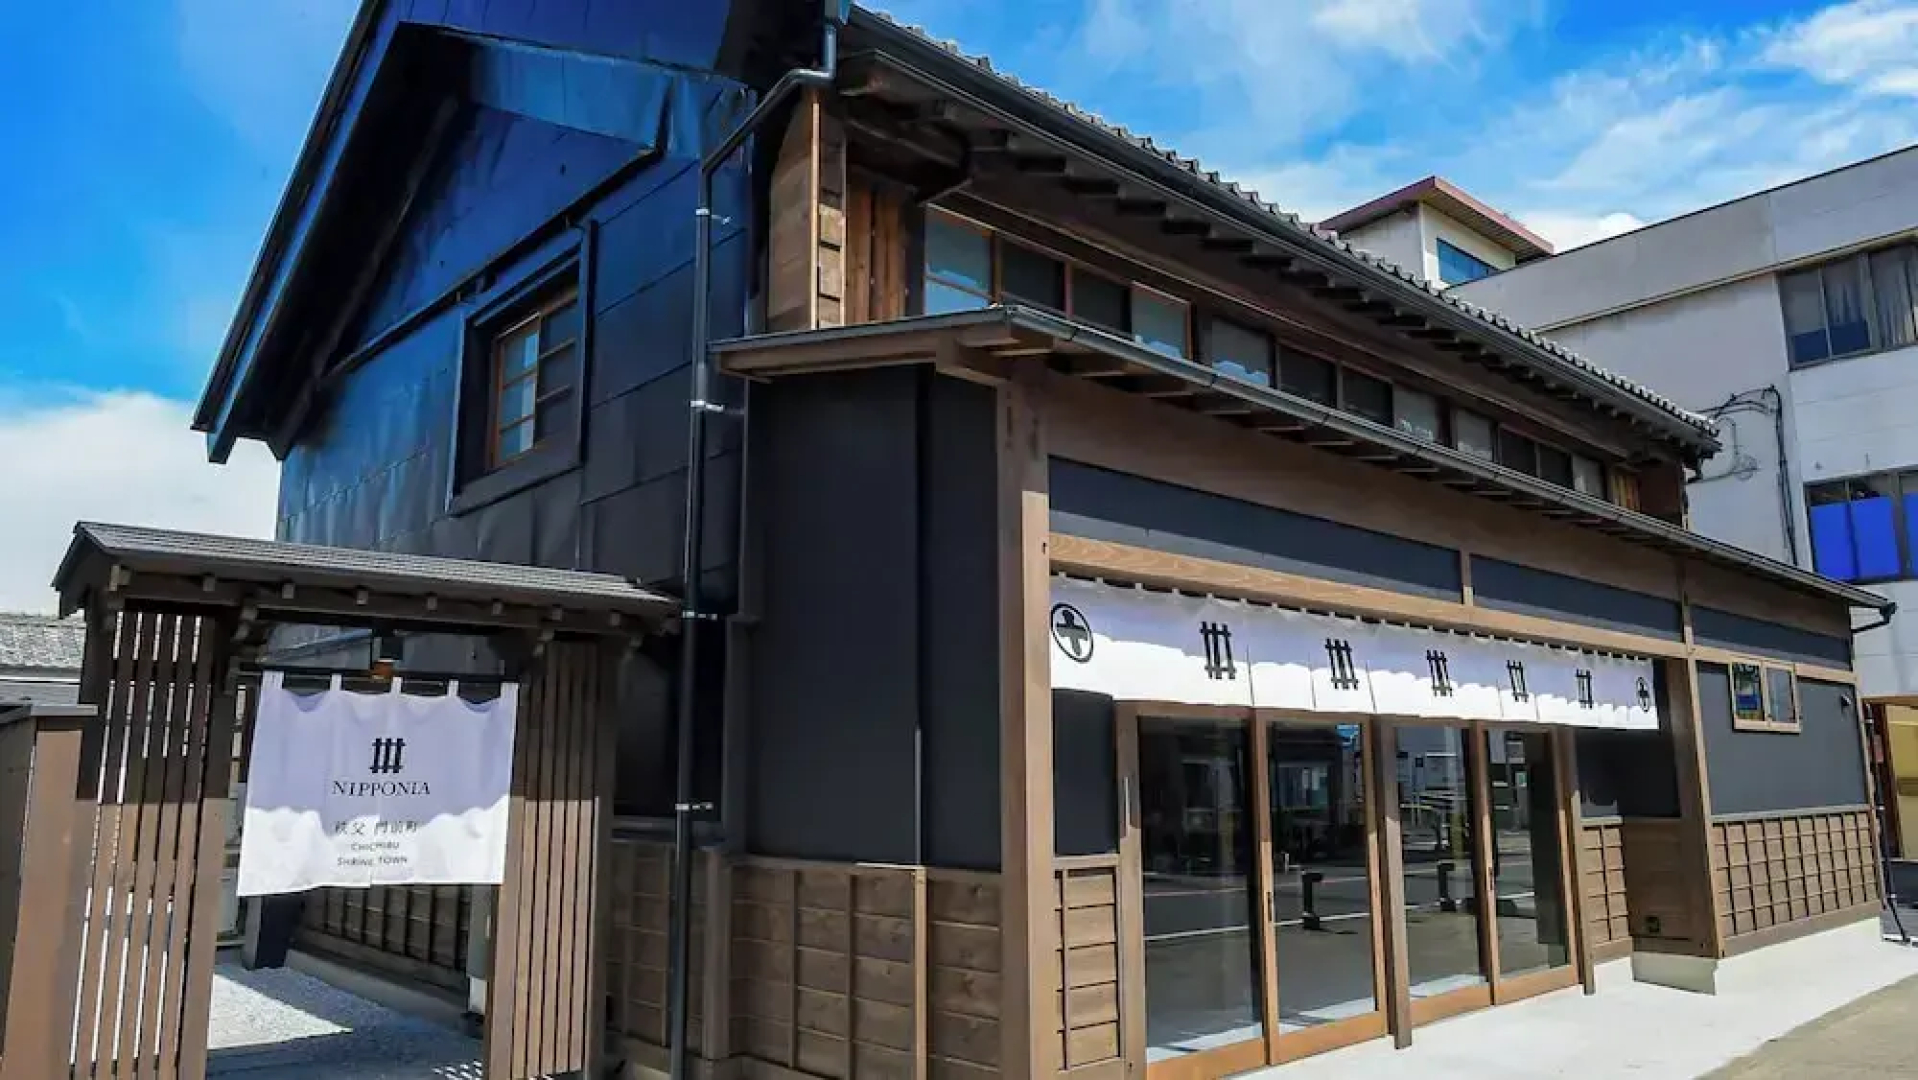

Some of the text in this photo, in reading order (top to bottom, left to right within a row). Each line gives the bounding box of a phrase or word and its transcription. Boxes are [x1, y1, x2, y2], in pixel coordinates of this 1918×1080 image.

[332, 780, 430, 797] NIPPONIA
[350, 841, 400, 852] CHICHIBU
[378, 856, 408, 865] TOWN
